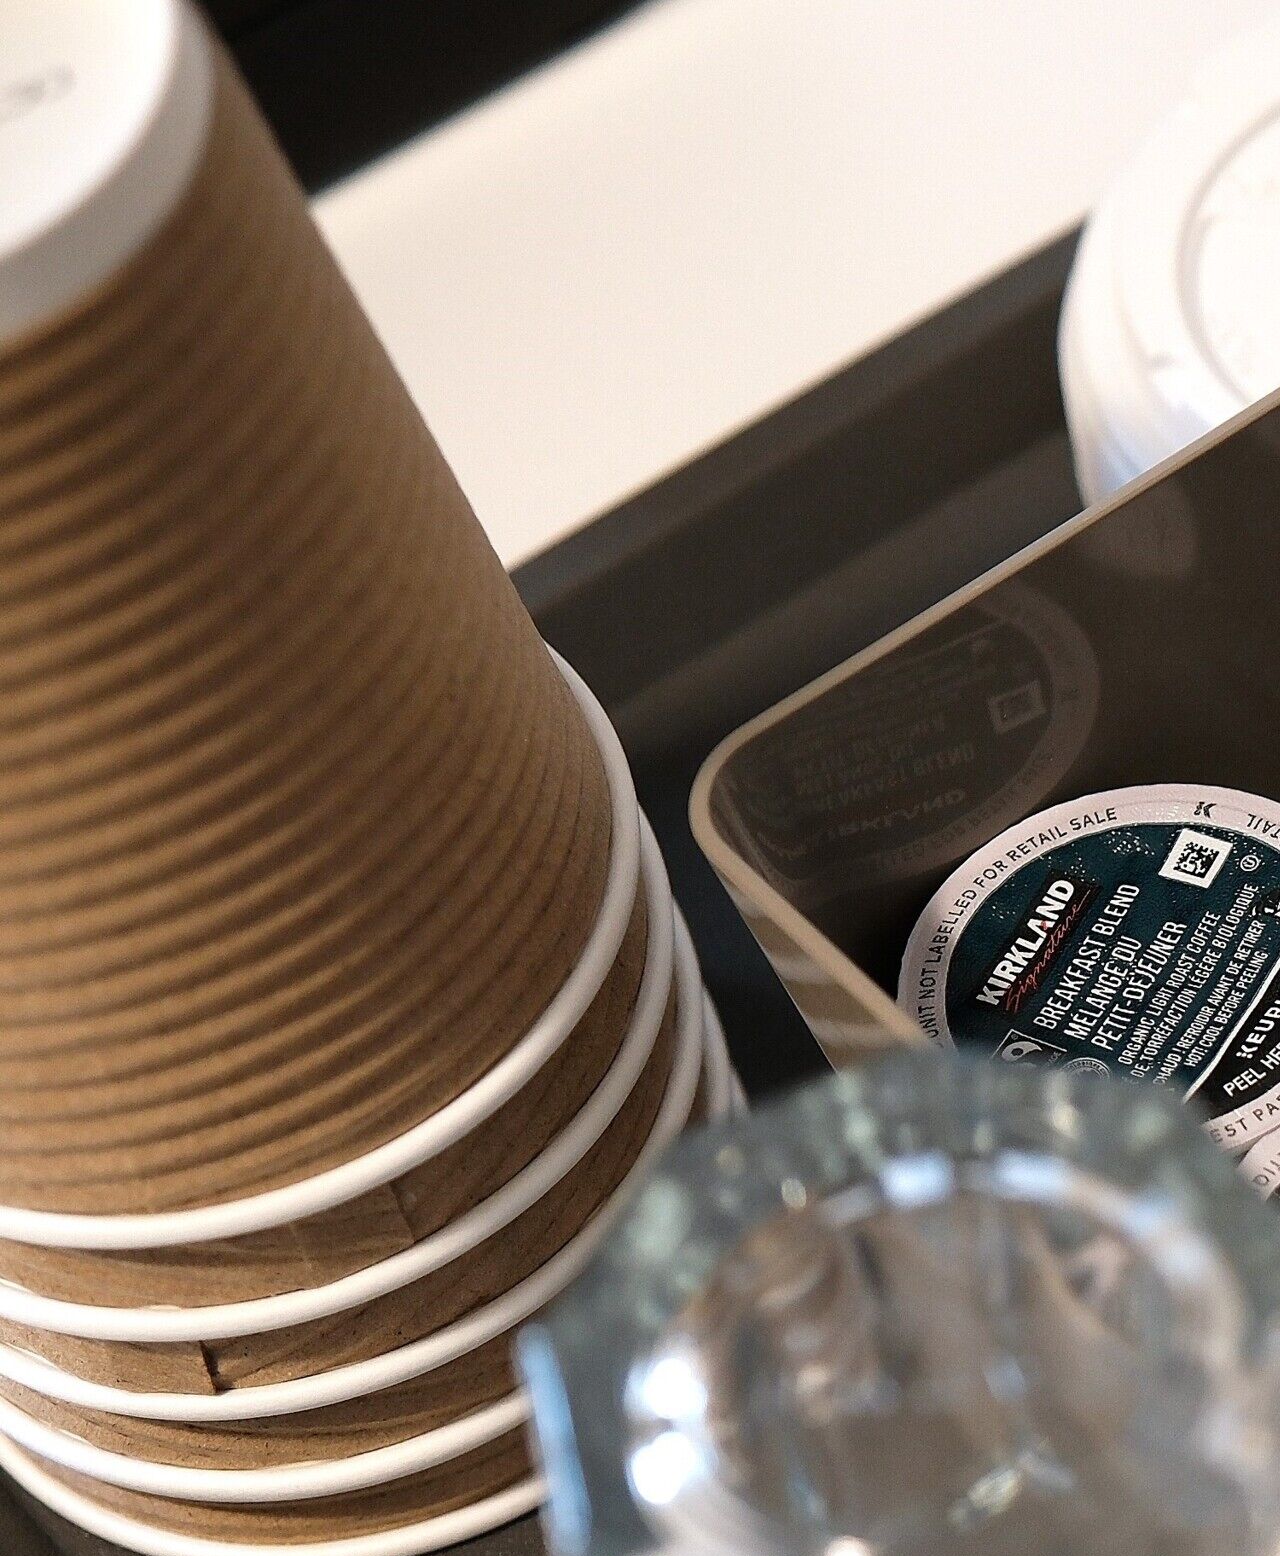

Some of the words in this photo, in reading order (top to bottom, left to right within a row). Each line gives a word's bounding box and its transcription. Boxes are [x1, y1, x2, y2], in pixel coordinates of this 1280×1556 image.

[1069, 807, 1117, 831] SALE
[1006, 825, 1068, 861] RETAIL
[973, 860, 1008, 888] FOR
[927, 889, 977, 963] LABELLED
[976, 879, 1075, 1006] KIRKLAND
[1233, 919, 1266, 960] RETIRER
[1005, 889, 1092, 1014] Signature
[1033, 936, 1106, 1030] BREAKFAST
[1091, 884, 1140, 936] BLEND
[1230, 956, 1243, 976] DE
[918, 968, 938, 1001] NOT
[1090, 921, 1188, 1050] PETIT-DÉJEUNER
[1118, 1016, 1155, 1065] ORGANIC
[1151, 987, 1173, 1022] LIGHT
[1165, 954, 1196, 990] ROAST
[1186, 911, 1221, 954] COFFEE
[1141, 989, 1198, 1067] TORRÉFACTION
[1190, 949, 1222, 990] LÉGÈRE
[1211, 883, 1259, 949] BIOLOGIQUE
[1207, 974, 1235, 1007] AVANT
[1063, 959, 1128, 1040] MÉLANGE
[1199, 1019, 1223, 1048] COOL
[1214, 989, 1246, 1026] BEFORE
[1235, 950, 1269, 990] PEELING
[917, 1004, 939, 1038] UNIT
[1182, 1004, 1216, 1050] REFROIDIR
[1223, 1067, 1267, 1098] PEEL
[1209, 1118, 1248, 1143] EST
